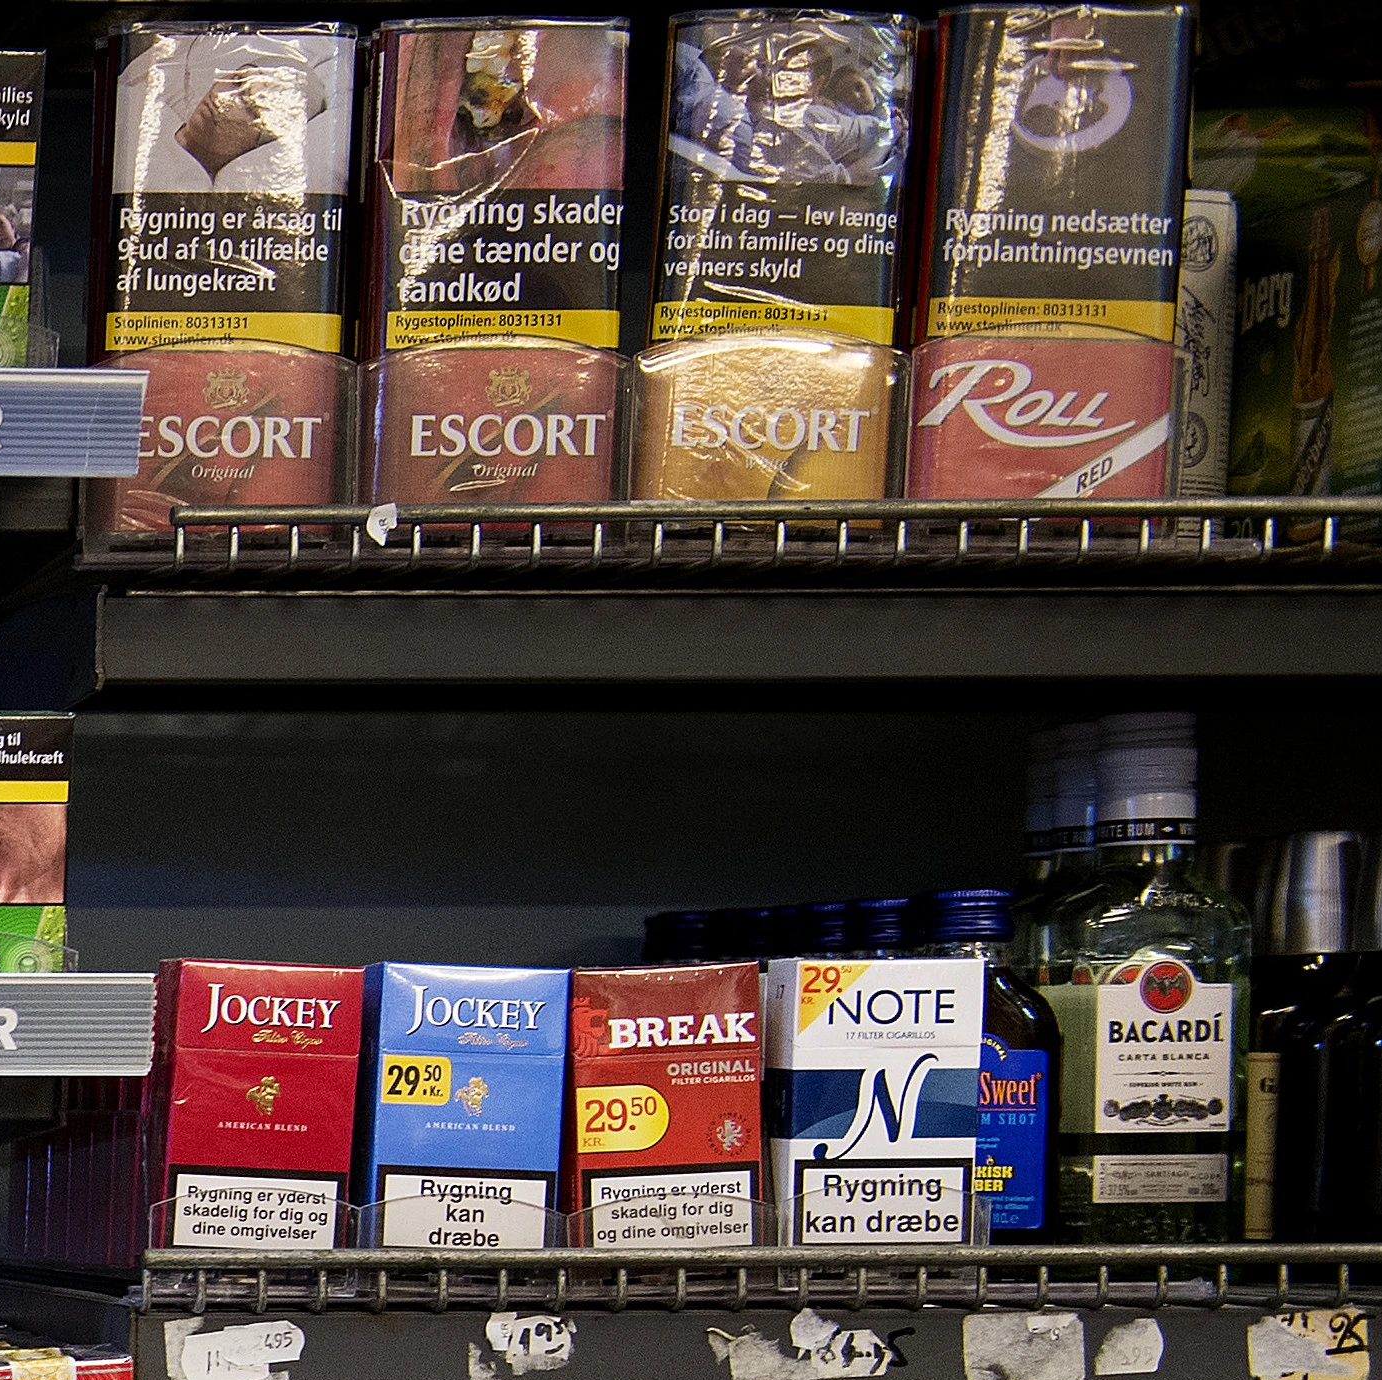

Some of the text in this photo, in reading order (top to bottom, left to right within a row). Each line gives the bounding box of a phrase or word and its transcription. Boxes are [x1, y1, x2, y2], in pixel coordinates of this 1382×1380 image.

[946, 203, 1171, 242] Rygning nedsætter
[944, 232, 1172, 271] forplantningsevnen
[396, 314, 561, 330] Rygestoplinien: 80313131
[411, 414, 605, 456] ESCORT
[201, 983, 341, 1034] JOCKEY
[829, 988, 955, 1024] NOTE
[609, 1013, 755, 1048] BREAK
[668, 1060, 755, 1075] ORIGINAL
[1163, 1053, 1210, 1061] BLANCA
[387, 1066, 418, 1095] 29
[423, 1065, 441, 1082] 50
[672, 1074, 756, 1085] FILTER CIGARILLOS
